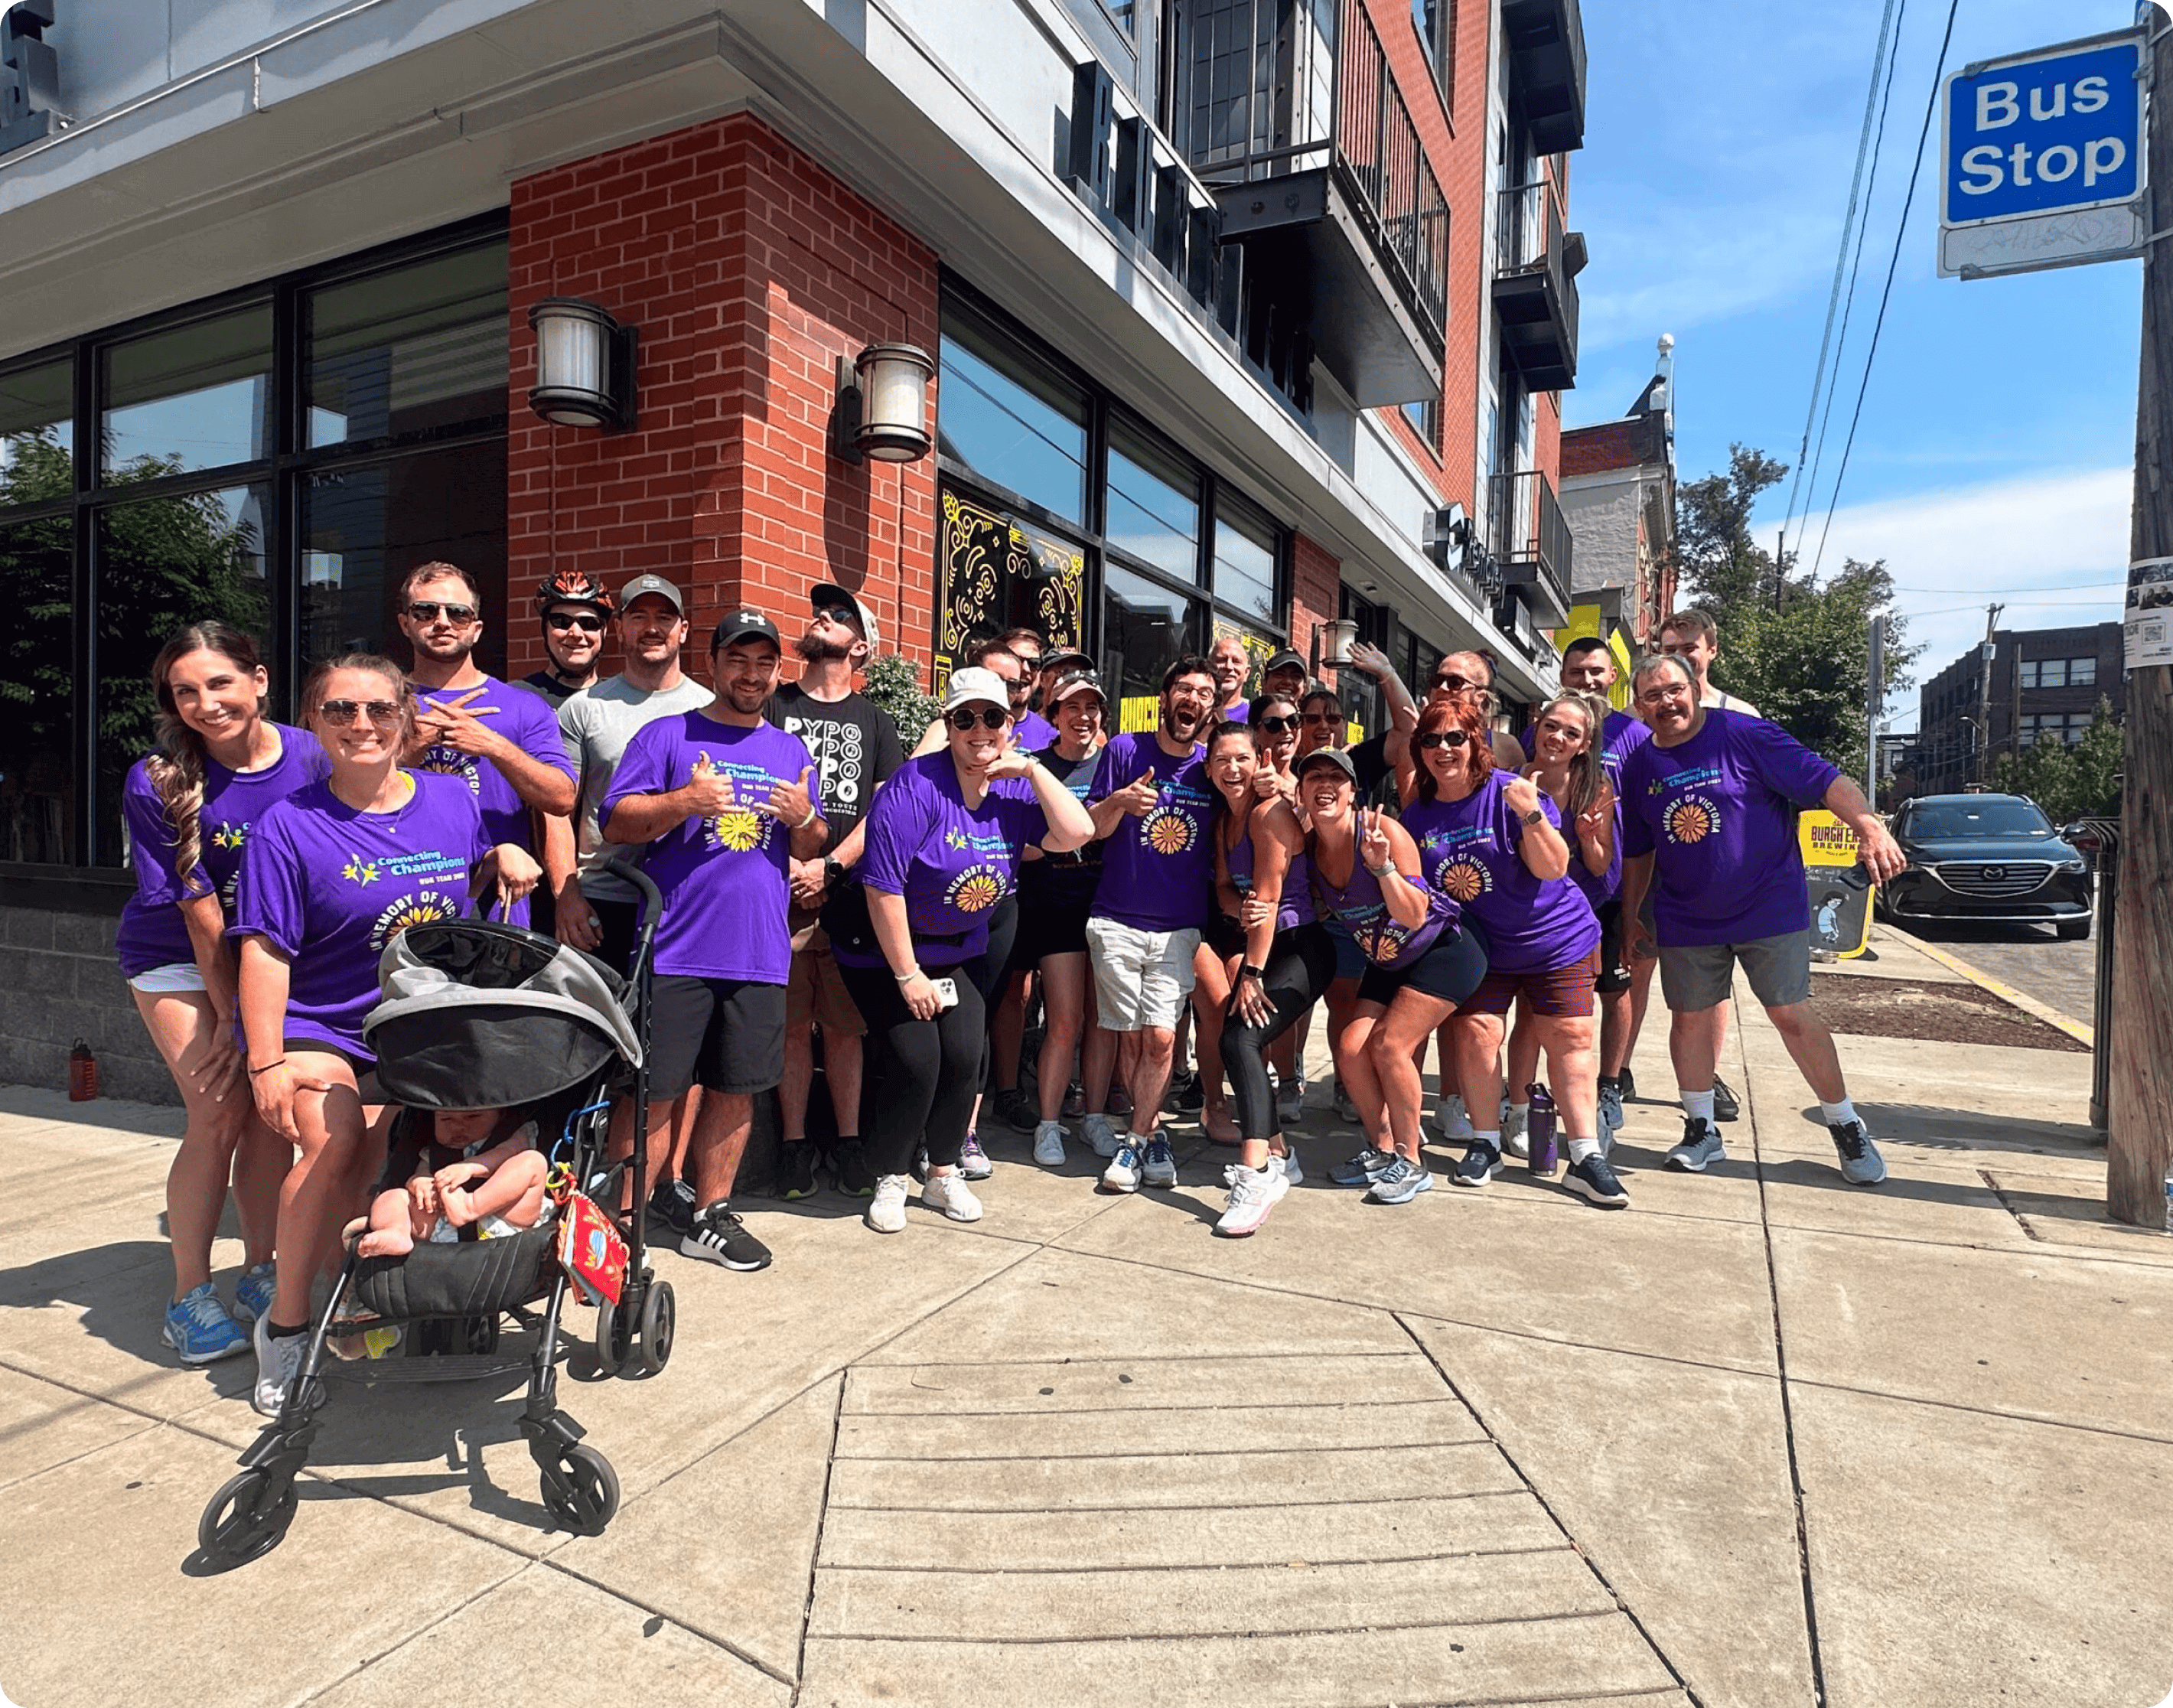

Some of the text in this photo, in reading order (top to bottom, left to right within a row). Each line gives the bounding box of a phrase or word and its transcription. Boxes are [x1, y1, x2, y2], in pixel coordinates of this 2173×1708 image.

[1976, 76, 2109, 132] Bus
[1959, 136, 2126, 195] Stop
[784, 716, 862, 743] PYPO
[801, 735, 862, 761] YPO
[442, 750, 458, 762] OF
[740, 794, 754, 805] OF
[760, 810, 772, 850] CTORIA
[1139, 805, 1198, 852] IN MEMORY OF VICTORIA
[1662, 797, 1682, 832] MEMORY
[1685, 794, 1696, 803] OF
[1699, 796, 1721, 833] VICTORIA
[377, 851, 441, 866] Connecting
[1812, 842, 1856, 851] BREWIN
[946, 864, 982, 894] MEMORY
[1458, 852, 1468, 862] OF
[1469, 854, 1493, 892] VICTORIA
[370, 893, 414, 940] MEMORY
[420, 890, 438, 905] OF
